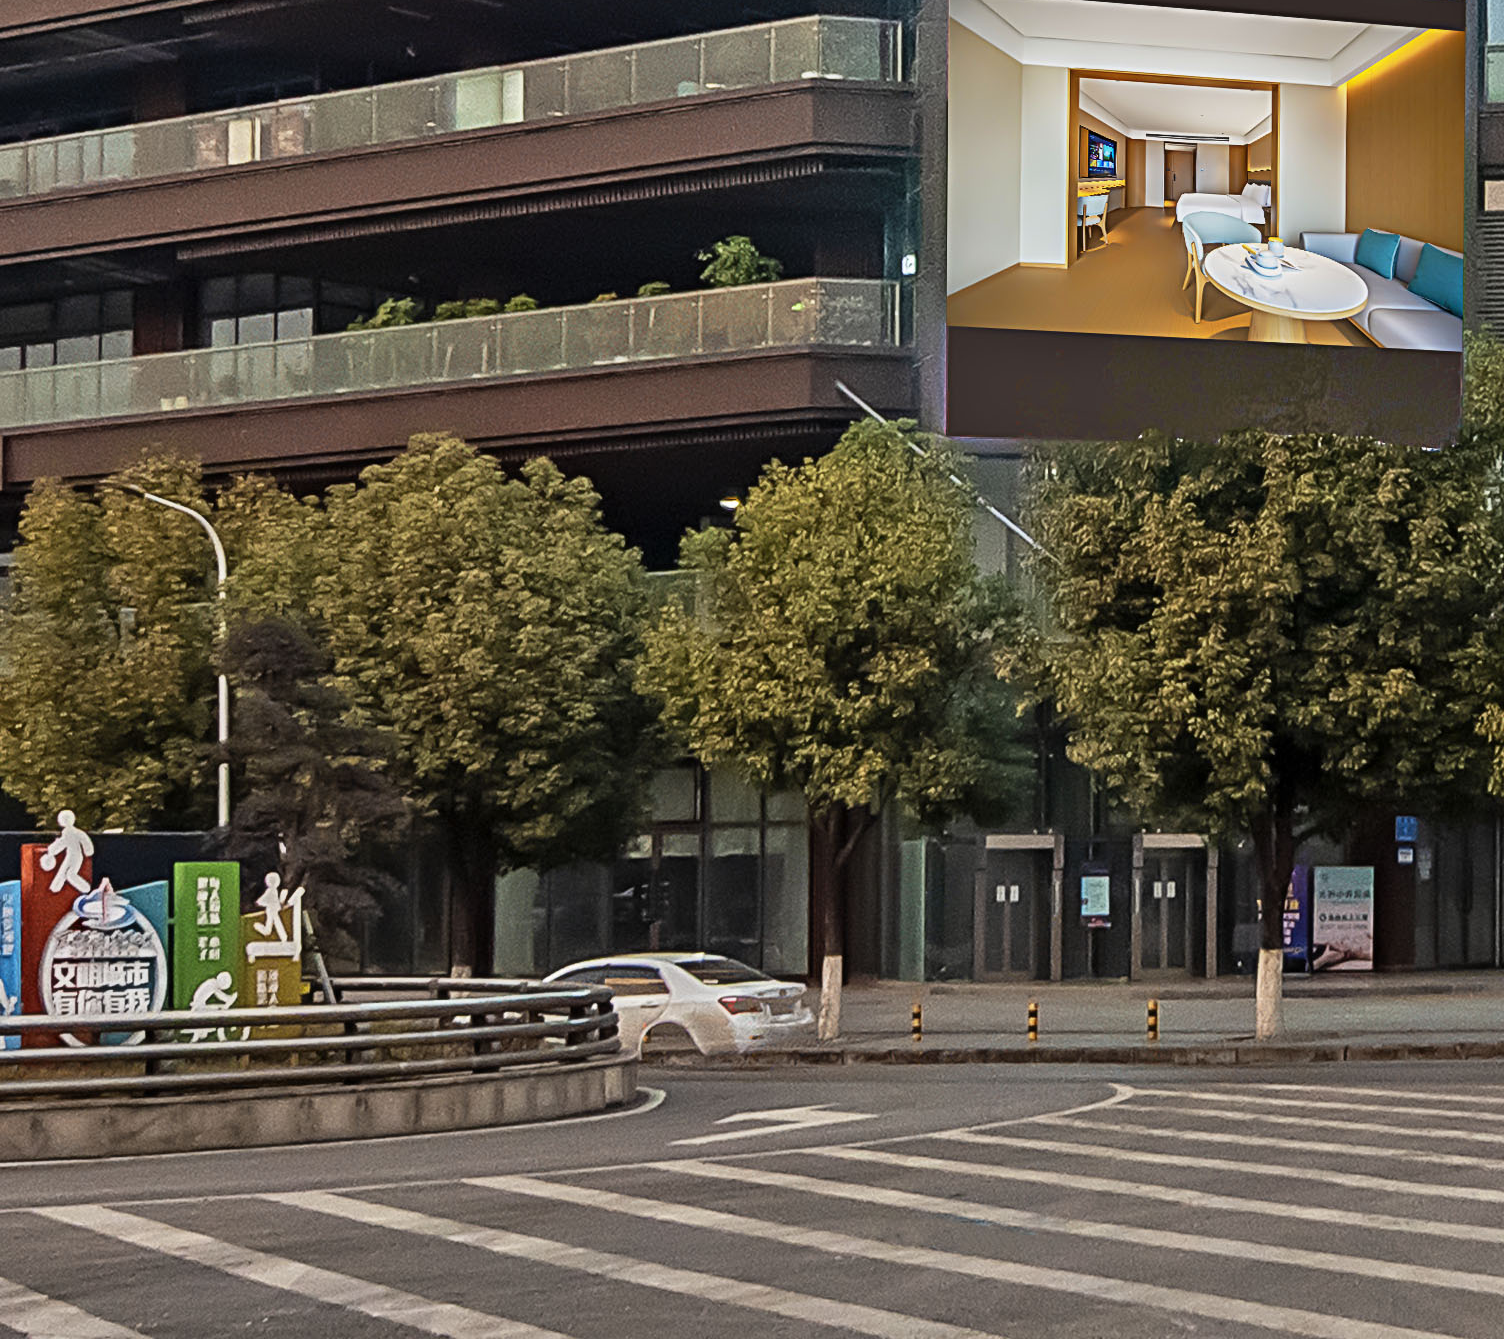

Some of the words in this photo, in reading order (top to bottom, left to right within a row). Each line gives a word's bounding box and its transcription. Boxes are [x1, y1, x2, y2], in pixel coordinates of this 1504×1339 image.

[52, 961, 151, 989] 文明城市
[52, 988, 151, 1016] 有你有我
